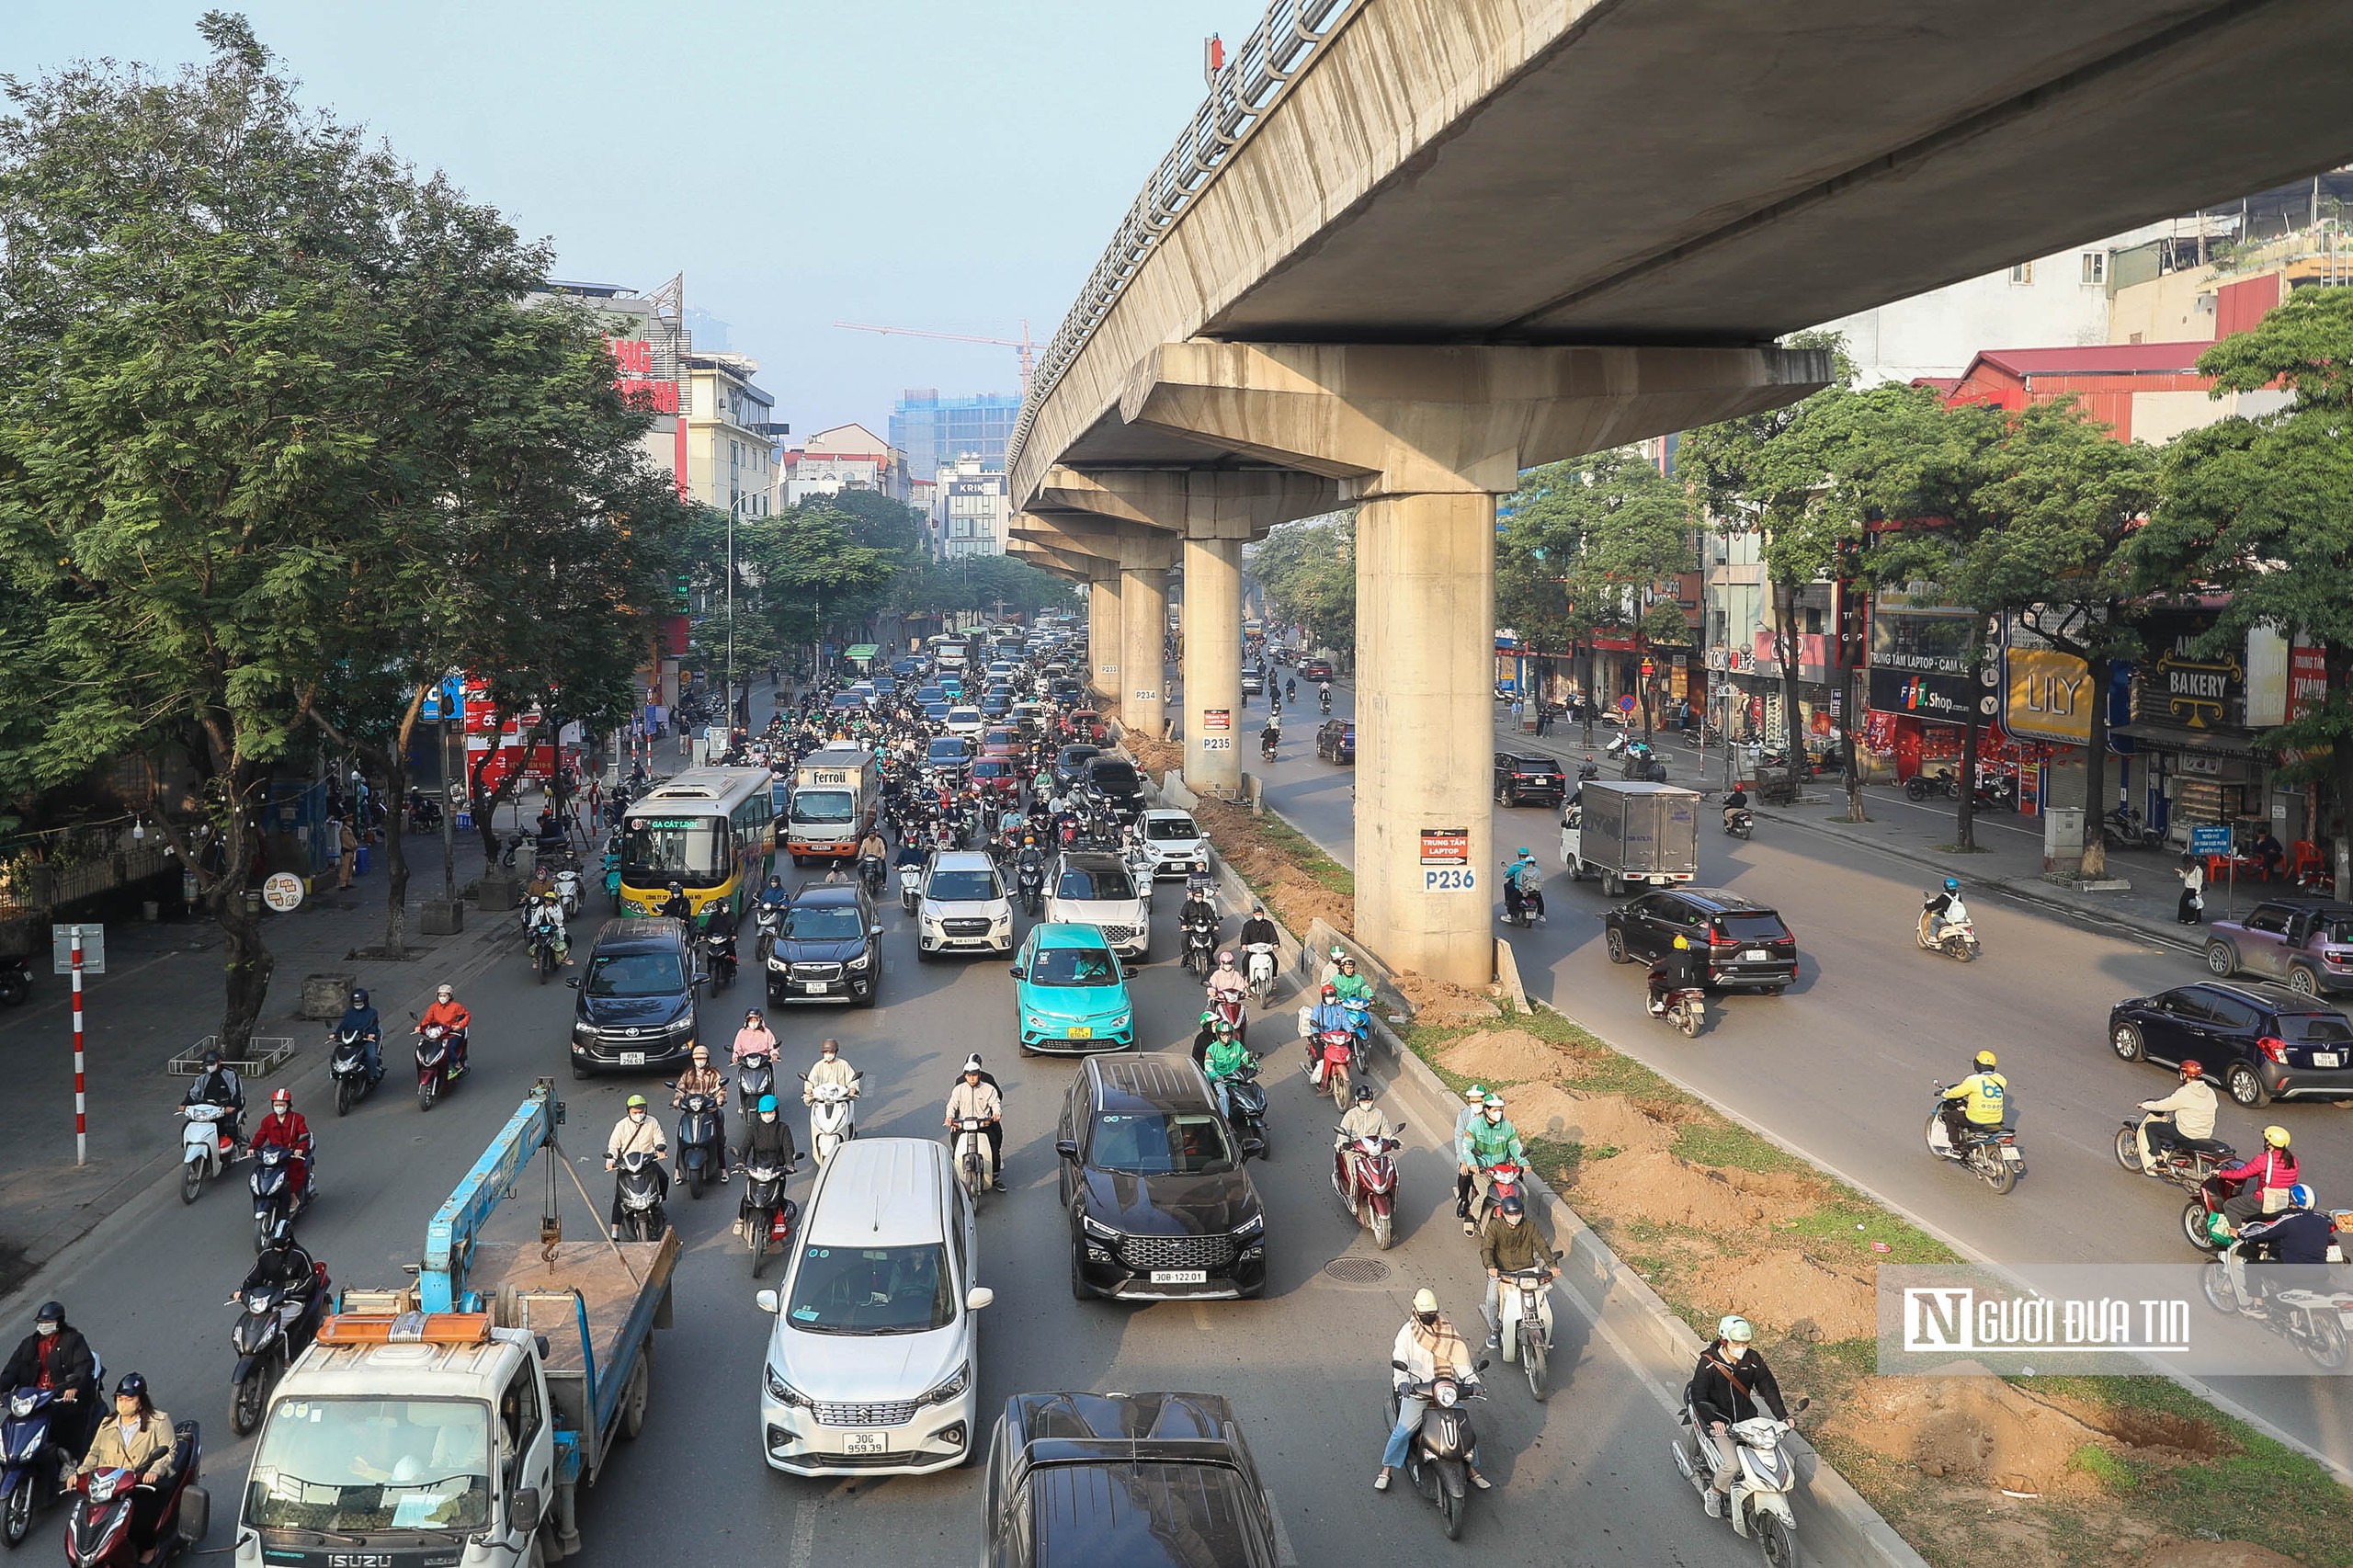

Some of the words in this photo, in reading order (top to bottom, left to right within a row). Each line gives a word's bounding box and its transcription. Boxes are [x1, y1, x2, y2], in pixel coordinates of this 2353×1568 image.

[1842, 633, 1863, 642] GP
[1870, 652, 1892, 665] TRUNG
[1908, 655, 1934, 670] LAPTOP
[1939, 659, 1958, 673] CAM
[2170, 672, 2227, 699] BAKERY
[2028, 675, 2083, 716] LILY
[1204, 738, 1230, 749] P235
[632, 820, 642, 828] 49
[1449, 837, 1466, 846] TÂM
[1427, 869, 1474, 890] P236
[855, 1434, 874, 1444] 30G
[847, 1444, 882, 1453] 959.39
[327, 1554, 392, 1568] ISUZU
